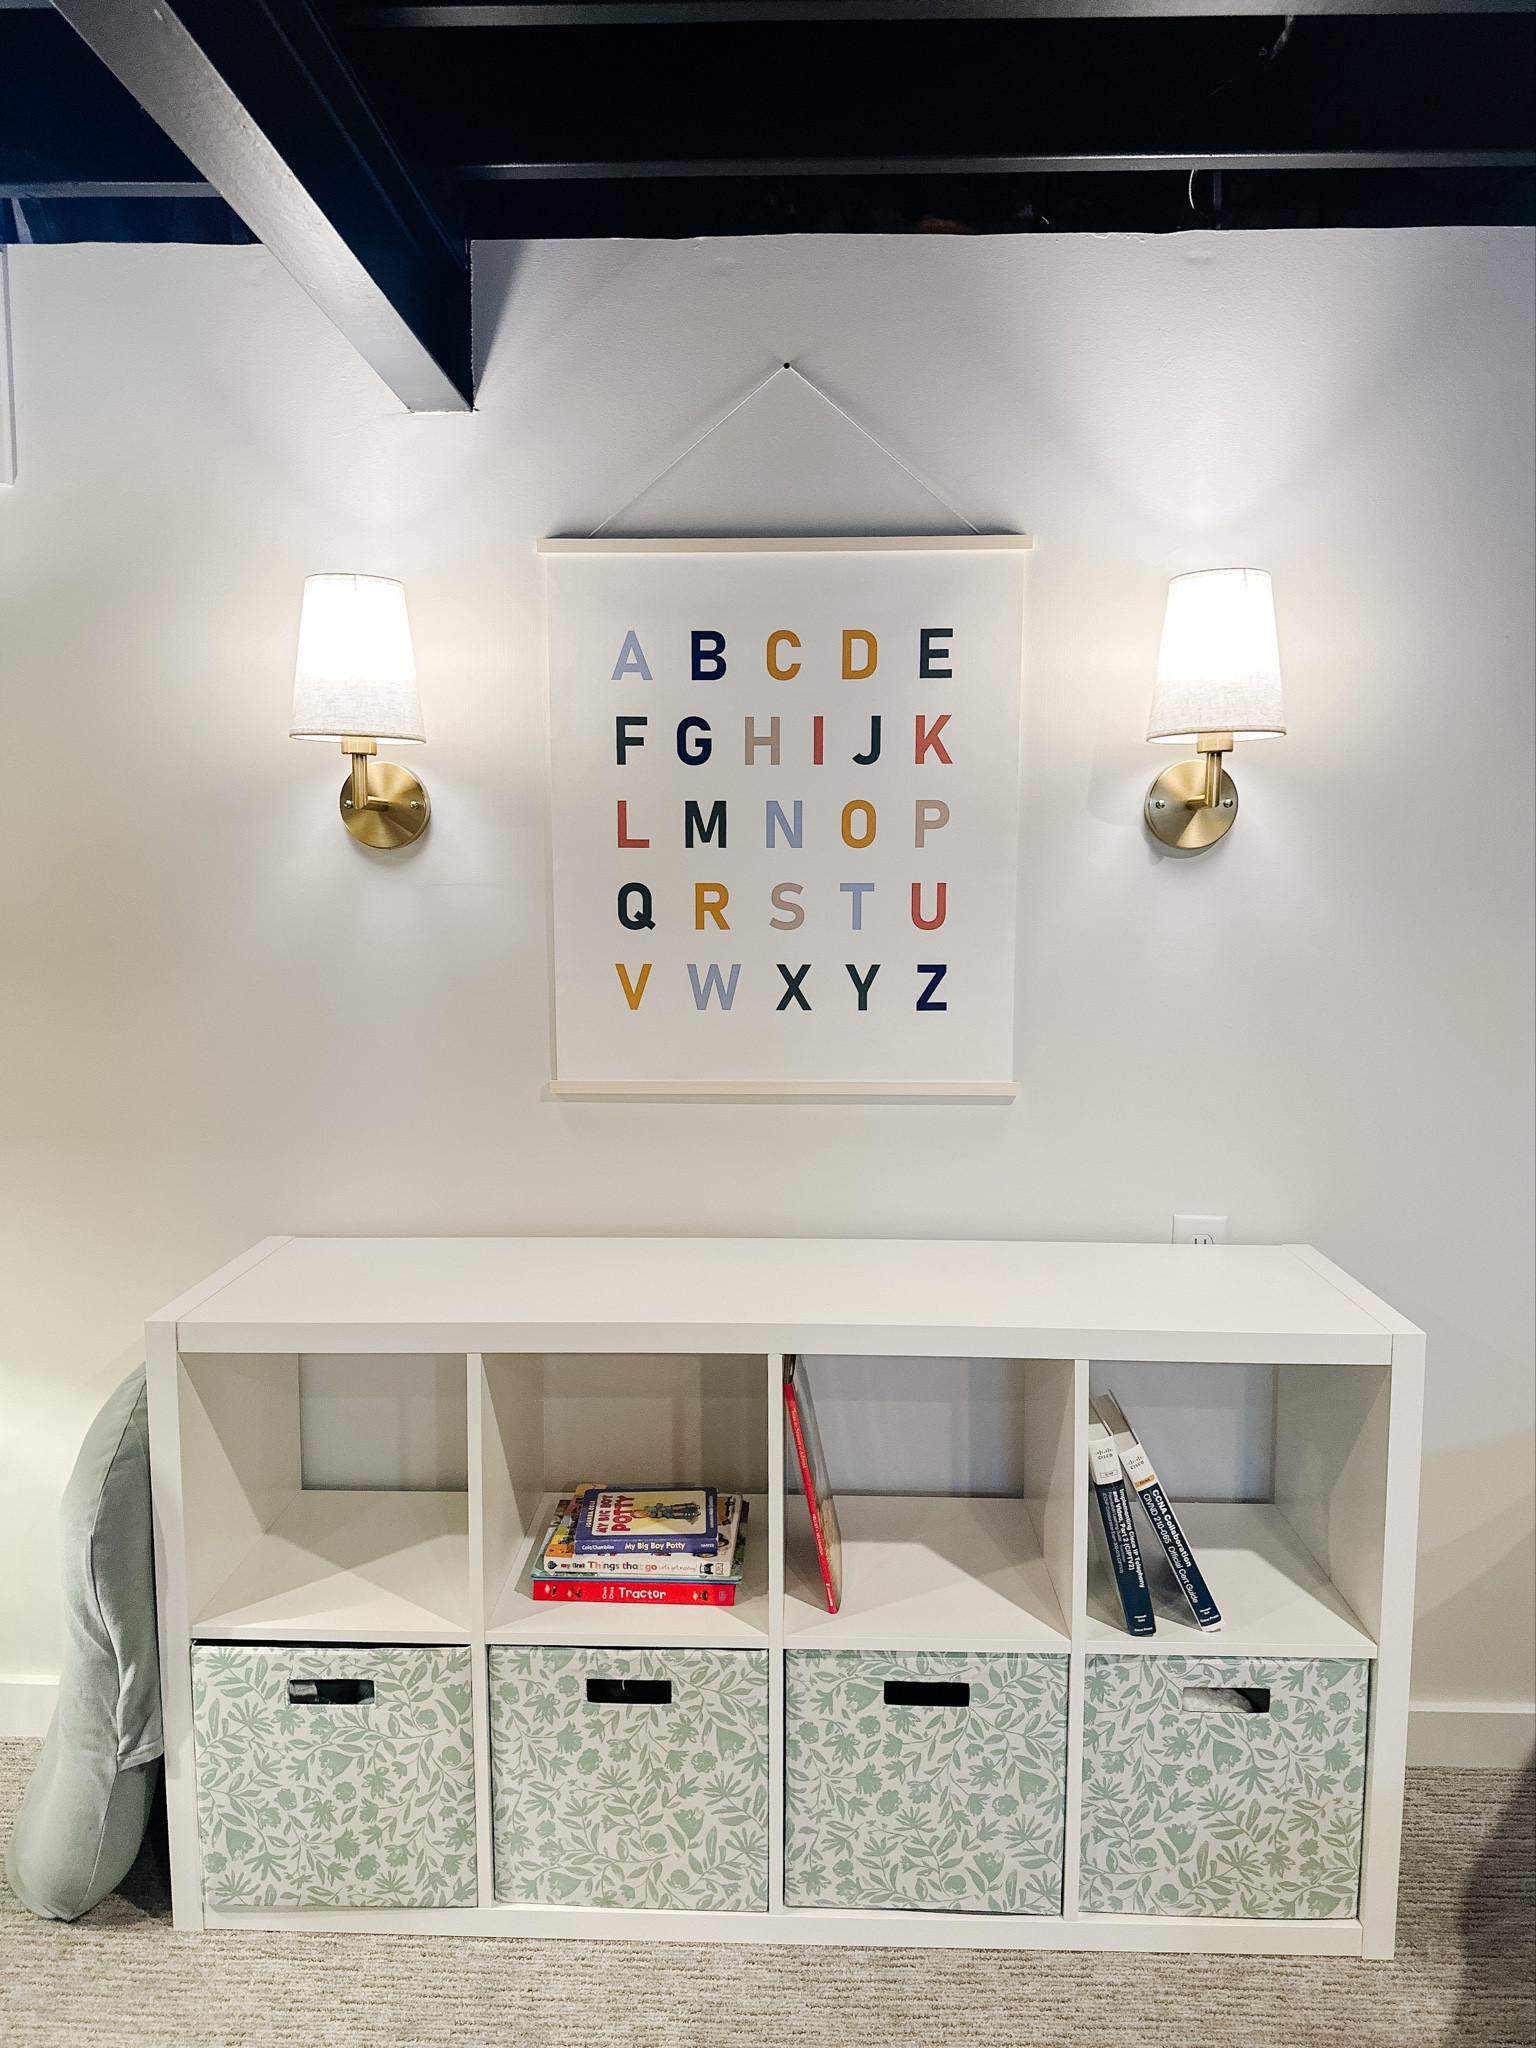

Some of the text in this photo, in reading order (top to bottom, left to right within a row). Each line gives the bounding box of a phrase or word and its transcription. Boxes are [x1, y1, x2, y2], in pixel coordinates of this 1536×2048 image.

[612, 628, 953, 681] A B C D E
[616, 714, 952, 766] F G H I J K
[617, 800, 949, 848] L M N O P
[618, 882, 946, 931] Q R S T U
[615, 963, 948, 1011] V W X Y Z
[1130, 1460, 1145, 1470] CISCO
[611, 1495, 635, 1531] POTTY
[1111, 1490, 1119, 1503] and
[1119, 1523, 1127, 1537] Part
[1151, 1488, 1193, 1568] CCNA Collaboration
[624, 1541, 686, 1551] My Big Boy Potty
[645, 1563, 657, 1572] go
[1153, 1515, 1171, 1544] 210-065
[1167, 1544, 1183, 1569] Official
[1178, 1567, 1190, 1584] Cert
[1184, 1583, 1199, 1604] Guide
[618, 1587, 667, 1600] Tractor
